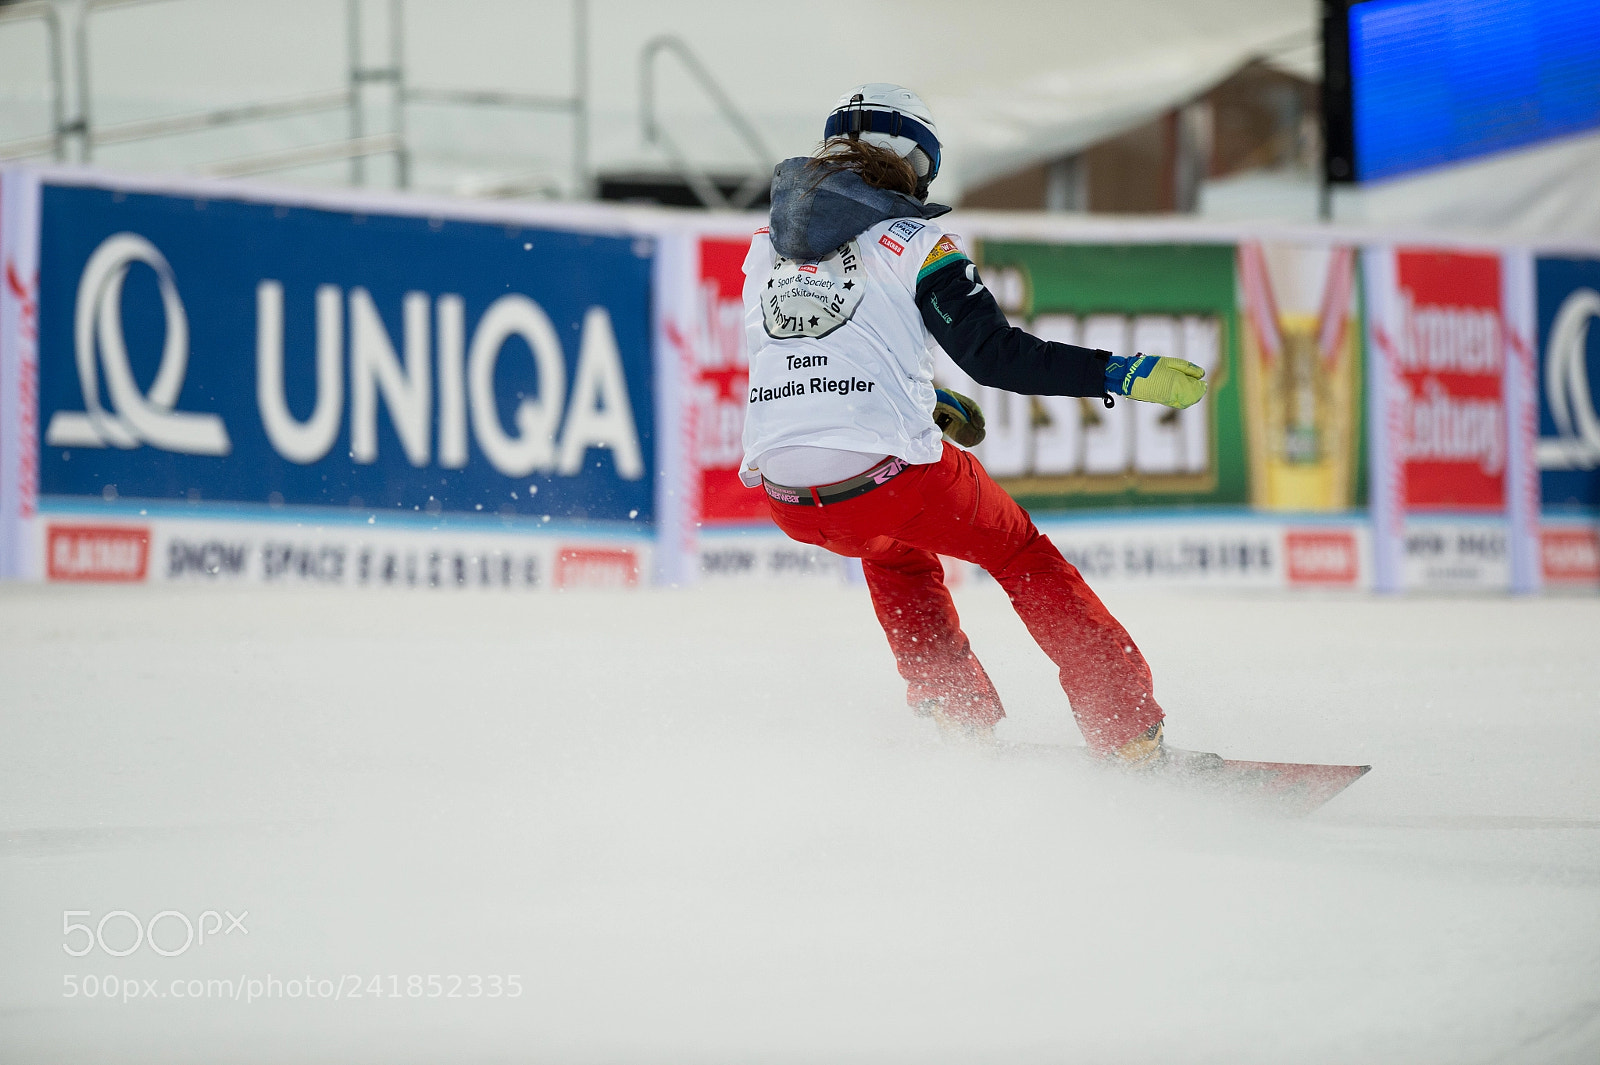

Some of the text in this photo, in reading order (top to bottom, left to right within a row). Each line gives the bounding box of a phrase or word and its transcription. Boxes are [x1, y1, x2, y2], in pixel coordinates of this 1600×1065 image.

[895, 223, 913, 235] SPACE
[804, 276, 836, 290] Society
[786, 354, 828, 370] Team
[256, 279, 643, 481] UNIQA
[749, 376, 876, 403] Claudia Riegler
